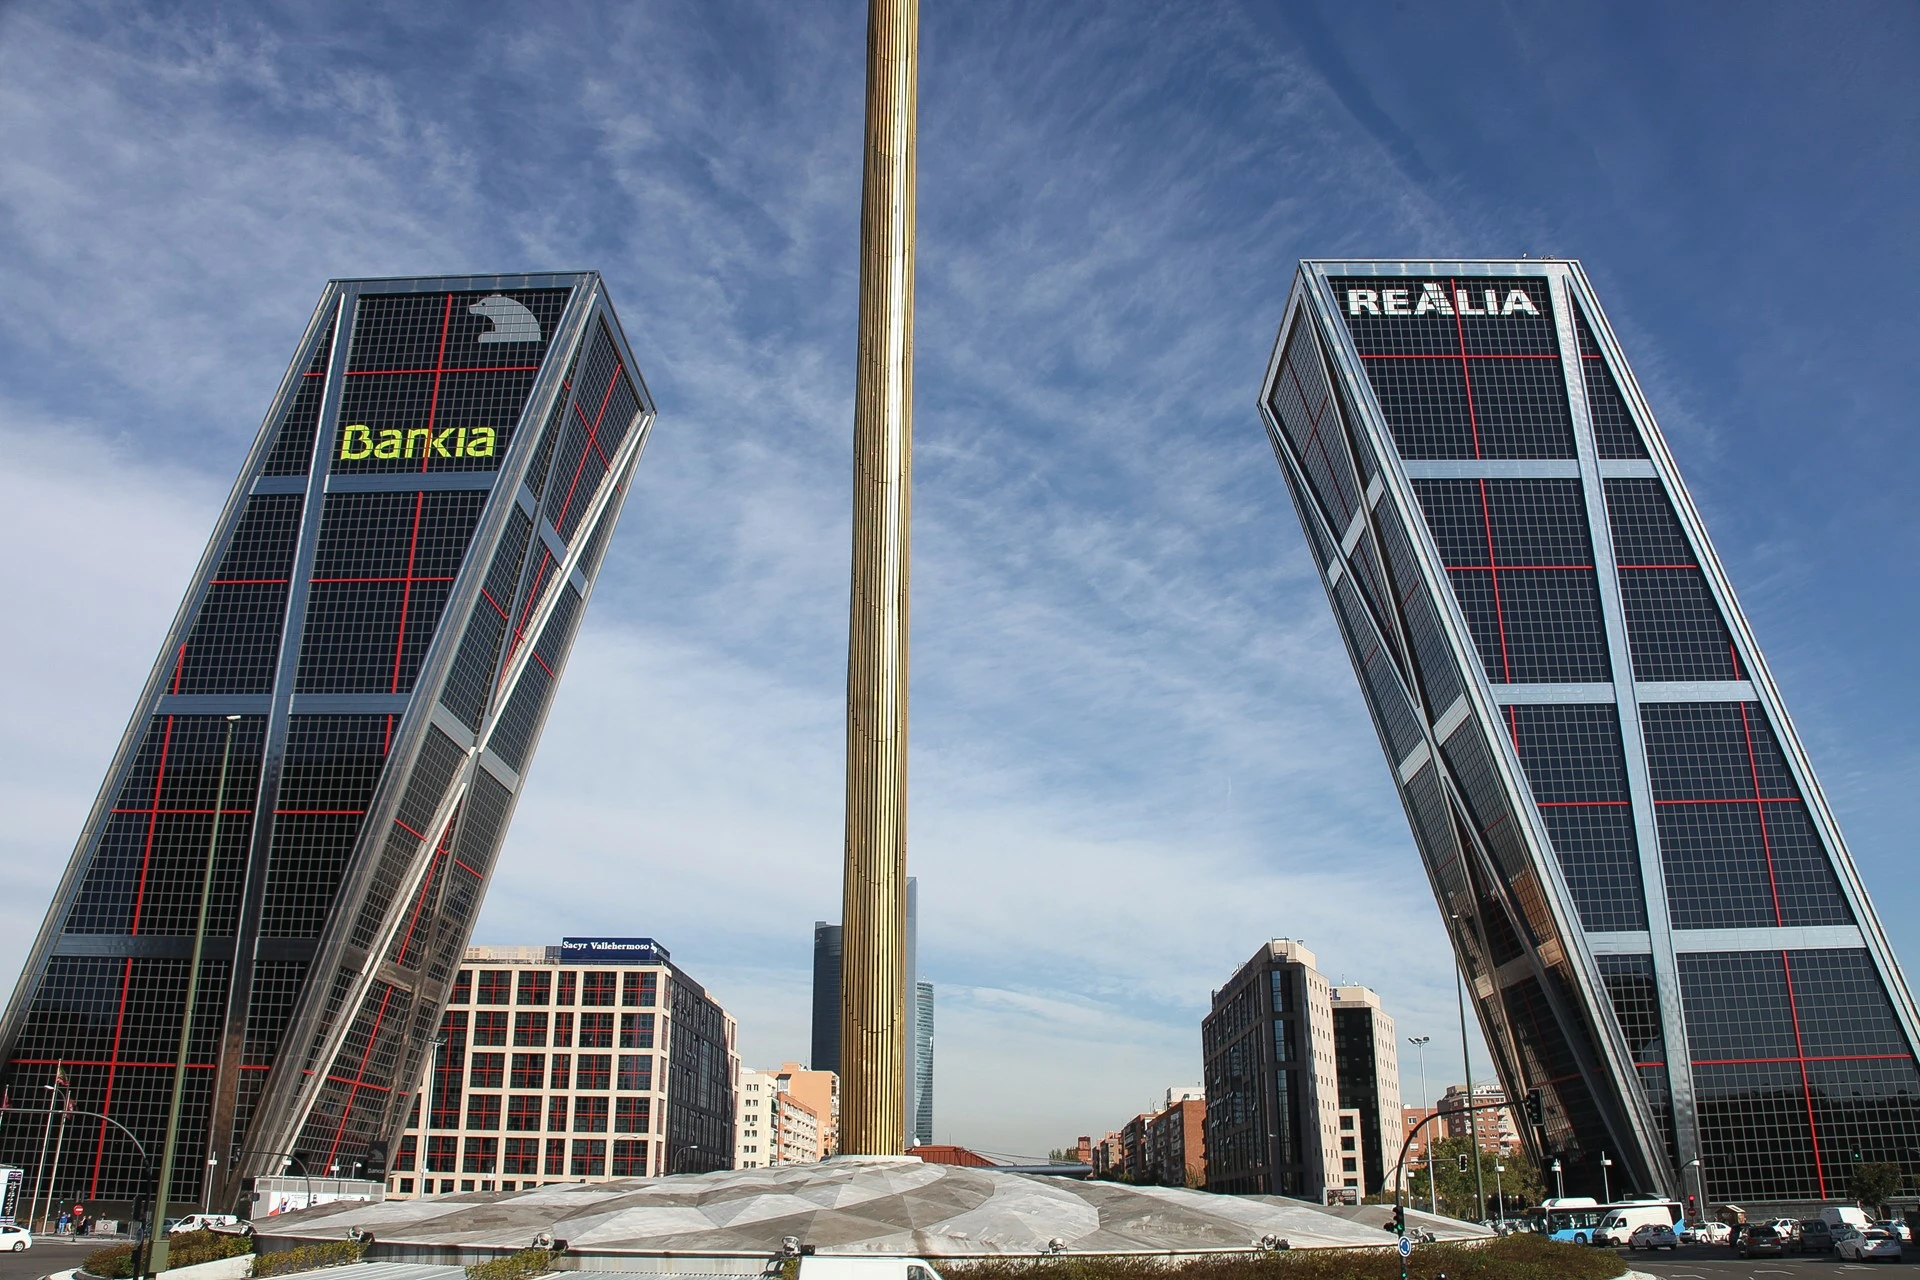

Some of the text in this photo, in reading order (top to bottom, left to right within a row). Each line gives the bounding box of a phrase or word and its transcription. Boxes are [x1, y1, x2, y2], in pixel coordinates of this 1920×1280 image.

[1347, 282, 1541, 316] REALIA
[340, 424, 496, 461] Bankia
[562, 941, 588, 951] Sacyr
[590, 941, 650, 951] Vallehermoso
